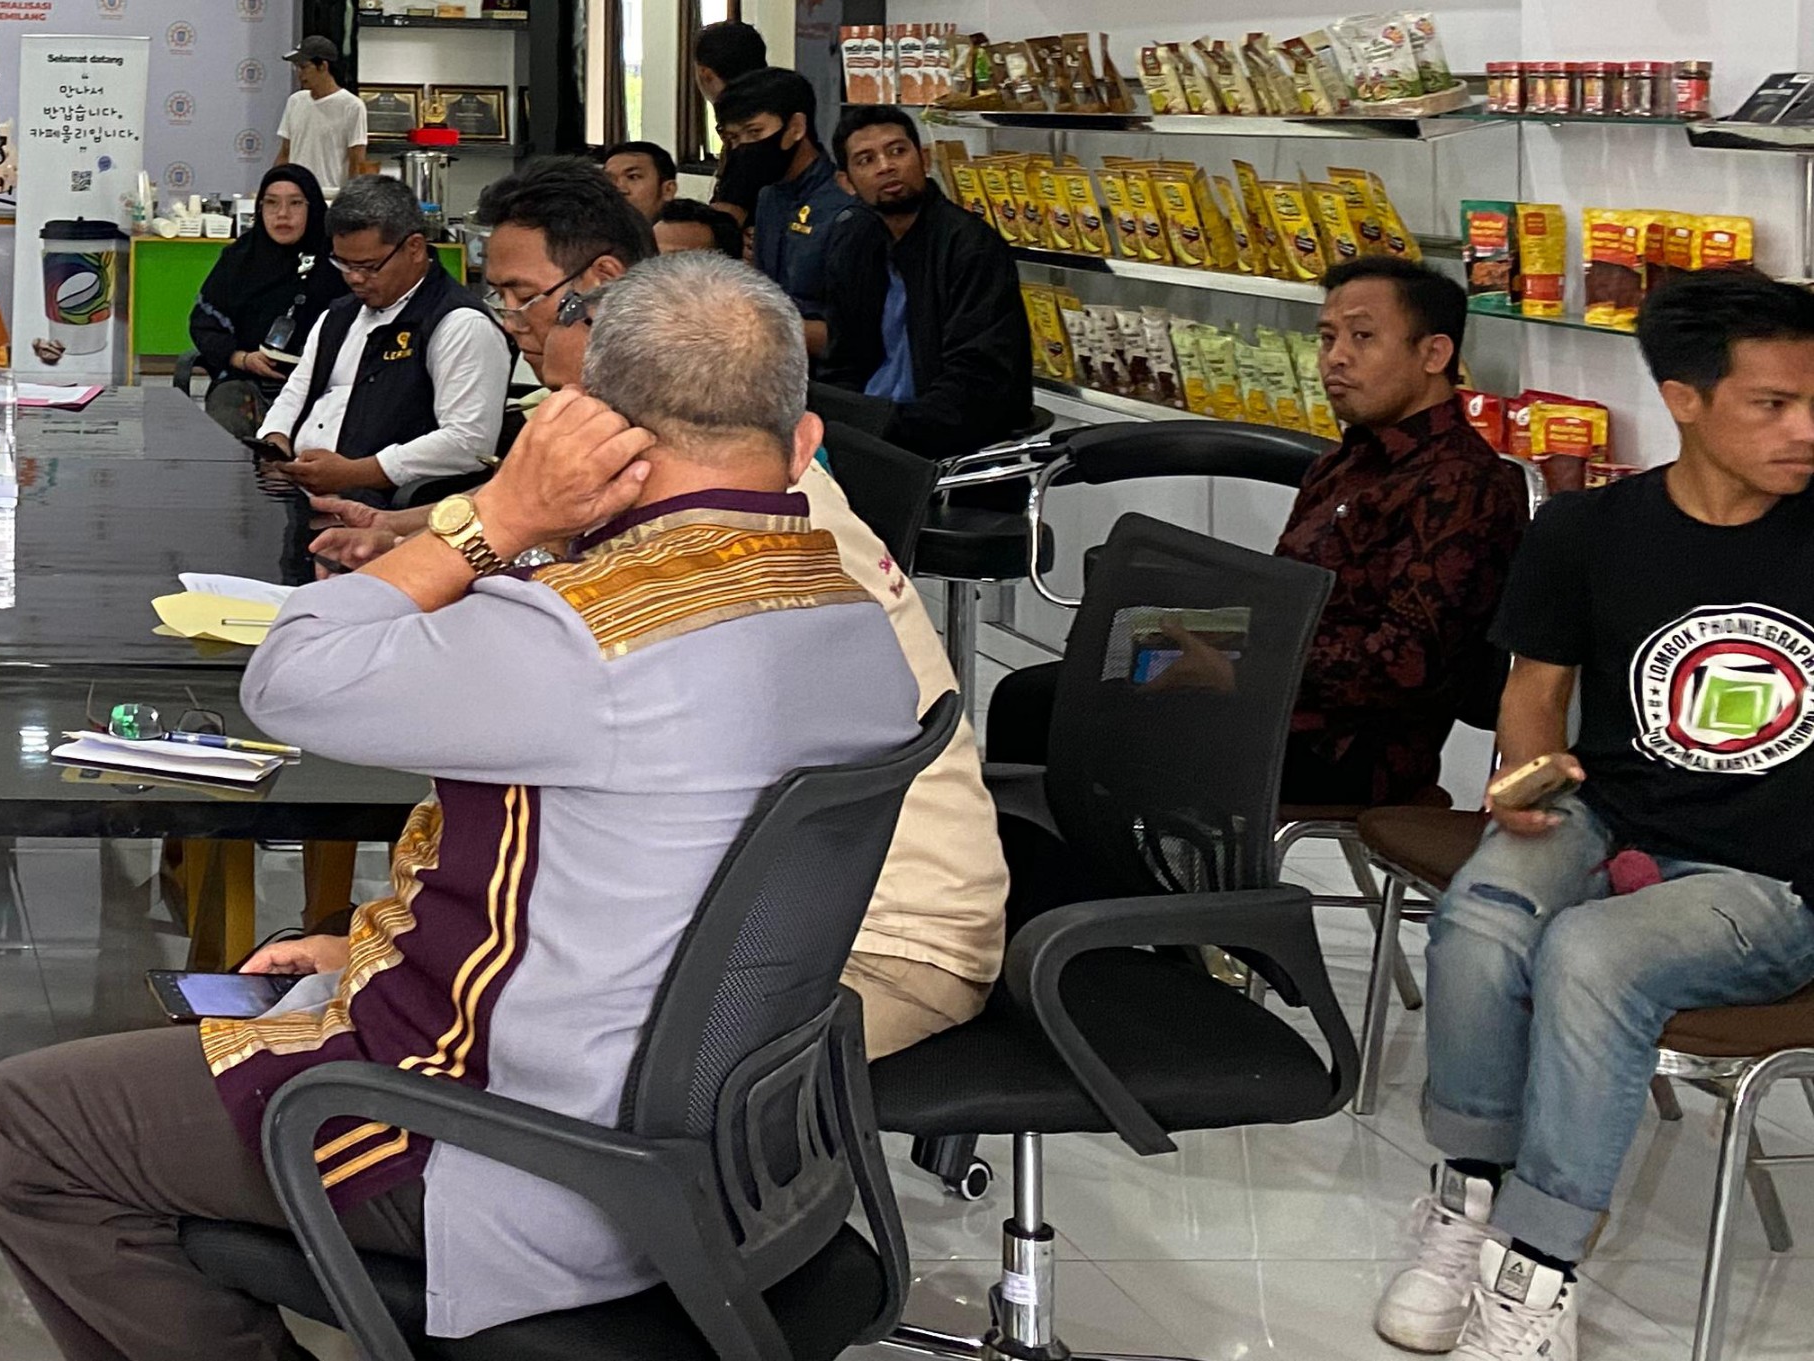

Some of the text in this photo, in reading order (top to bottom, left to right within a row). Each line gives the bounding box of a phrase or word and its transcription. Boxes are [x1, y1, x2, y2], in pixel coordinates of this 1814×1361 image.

[47, 54, 123, 66] Selamat datang
[43, 103, 124, 122] 반갑습니다.
[1649, 618, 1814, 683] LOMBOK PHONEGRAPH
